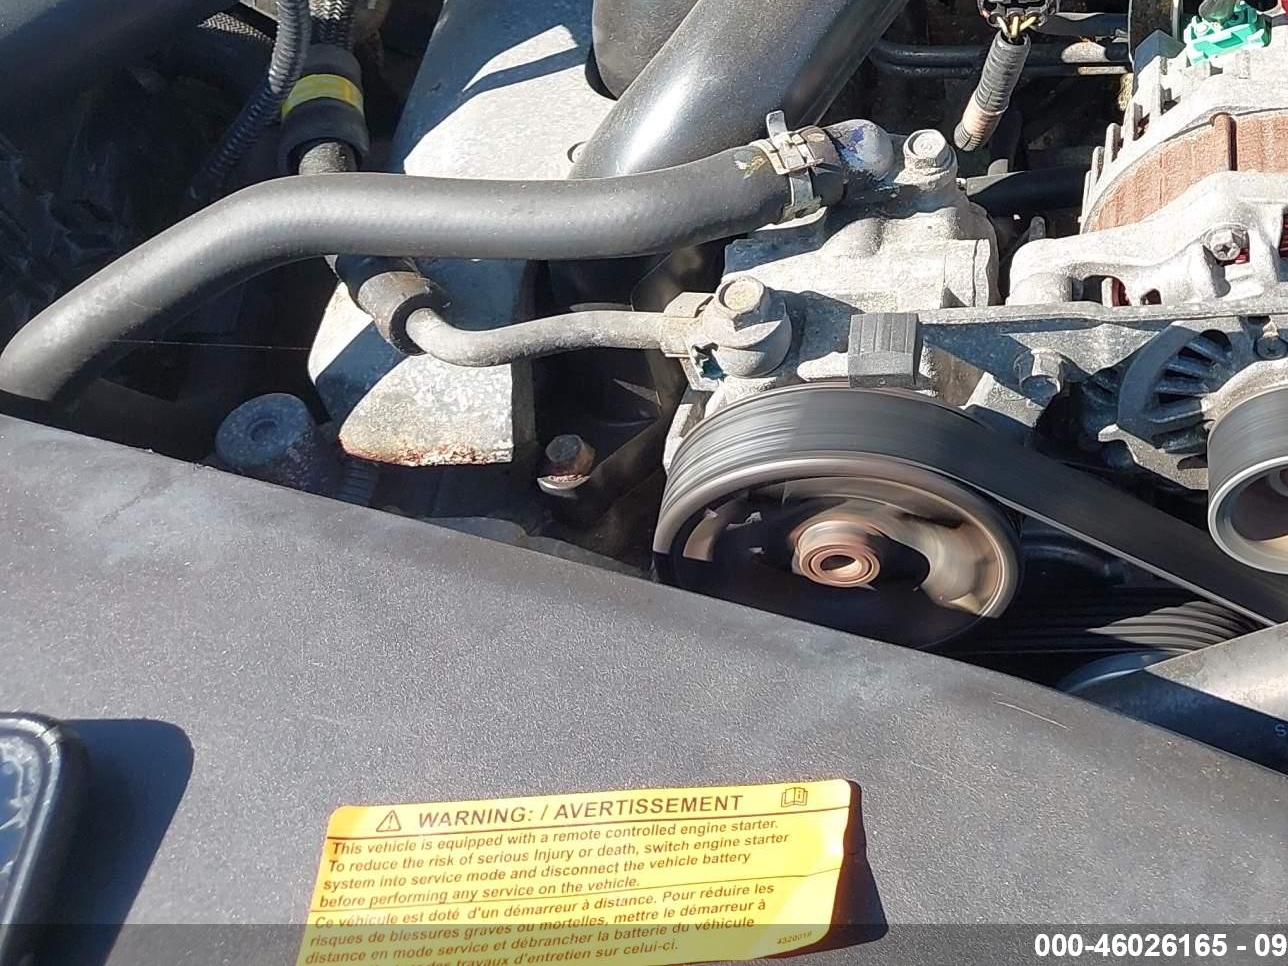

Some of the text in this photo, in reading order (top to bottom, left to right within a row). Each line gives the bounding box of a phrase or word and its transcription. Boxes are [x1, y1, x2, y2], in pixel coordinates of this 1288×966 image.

[418, 794, 744, 828] WARNING: / AVERTISSEMENT
[328, 833, 789, 872] To reduce the risk of serious Injury or death, switch engine starter
[331, 818, 779, 856] This vehicle is equipped with a remote controlled engine starter.
[323, 851, 751, 893] system into service mode and disconnect the vehicle battery
[315, 883, 775, 929] Ce véhicule est doté d'un démarreur à distance. Pour réduire les
[319, 877, 640, 909] before performing any service on the vehicle.
[305, 950, 367, 965] distance
[370, 949, 388, 960] en
[392, 945, 434, 959] mode
[437, 942, 489, 955] service
[493, 940, 508, 952] et
[511, 932, 592, 950] débrancher
[597, 930, 609, 943] la
[613, 924, 667, 940] batterie
[672, 923, 690, 937] du
[693, 916, 755, 932] véhicule
[310, 900, 766, 948] risques de blessures graves ou mortelles, mettre le démarreur à
[513, 946, 593, 965] d'entretien
[595, 946, 619, 959] sur
[622, 941, 679, 955] celui-ci.
